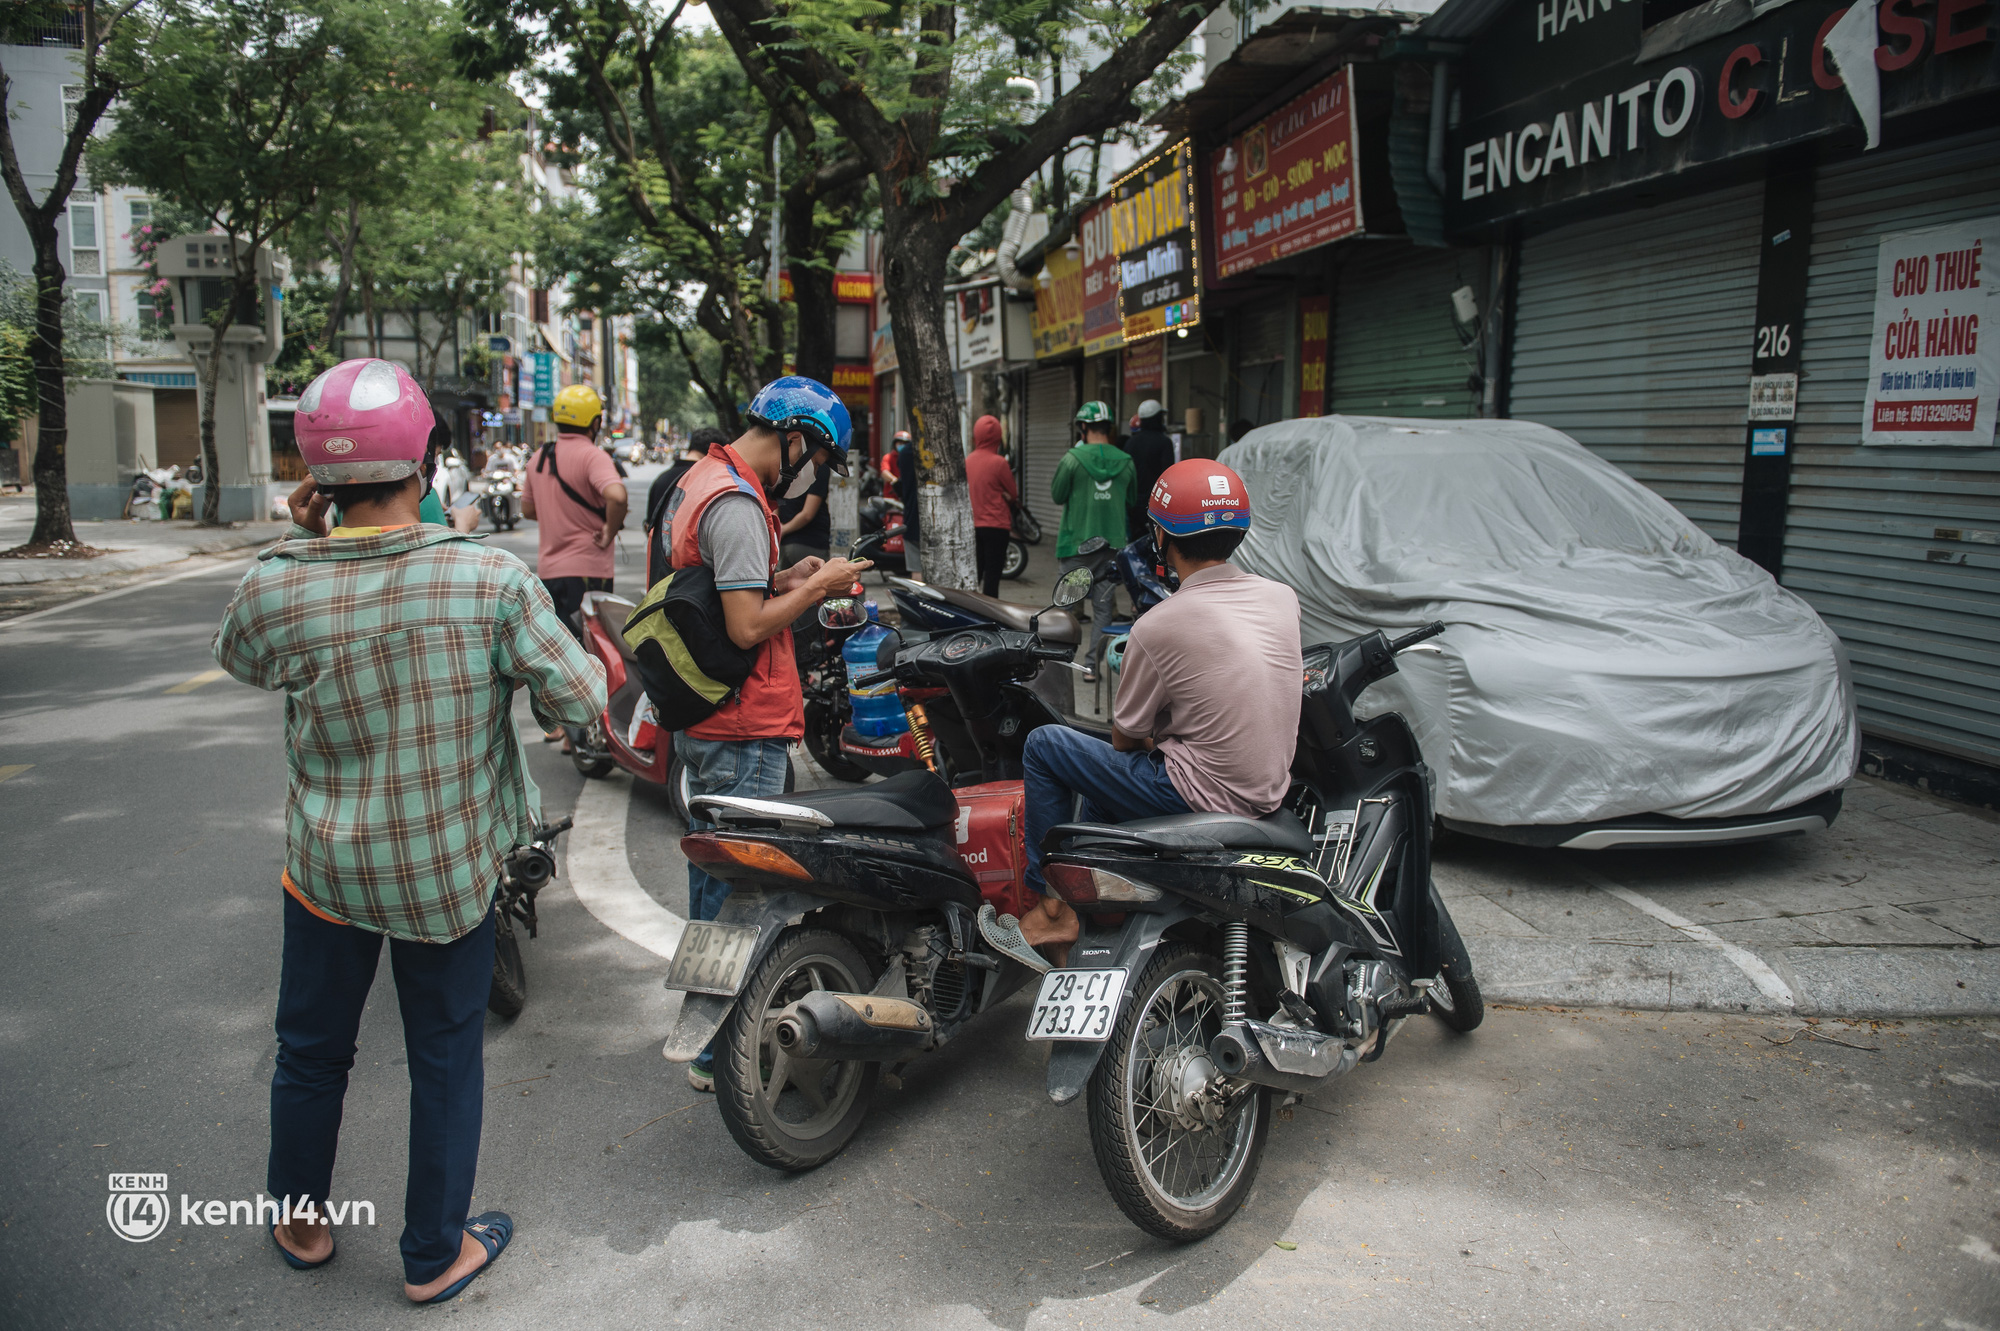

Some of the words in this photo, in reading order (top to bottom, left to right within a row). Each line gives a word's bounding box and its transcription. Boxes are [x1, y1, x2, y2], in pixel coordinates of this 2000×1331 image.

[1462, 66, 1696, 200] ENCANTO
[1893, 255, 1929, 298] CHO
[1935, 238, 1983, 292] THUÊ
[1756, 323, 1791, 359] 216
[1885, 307, 1920, 361] CỬA
[1924, 308, 1979, 358] HÀNG
[1877, 407, 1895, 423] Liên
[1896, 406, 1909, 425] hệ:
[1910, 404, 1973, 423] 0913290545
[328, 440, 349, 452] Safe
[1093, 491, 1111, 500] Grab
[1201, 497, 1240, 508] NowFood
[844, 833, 918, 851] CLICK
[1236, 853, 1305, 871] RSX
[686, 926, 745, 958] 30-F1
[675, 956, 736, 988] 6498
[1048, 973, 1113, 1002] 29-C1
[1032, 1005, 1111, 1035] 733.73
